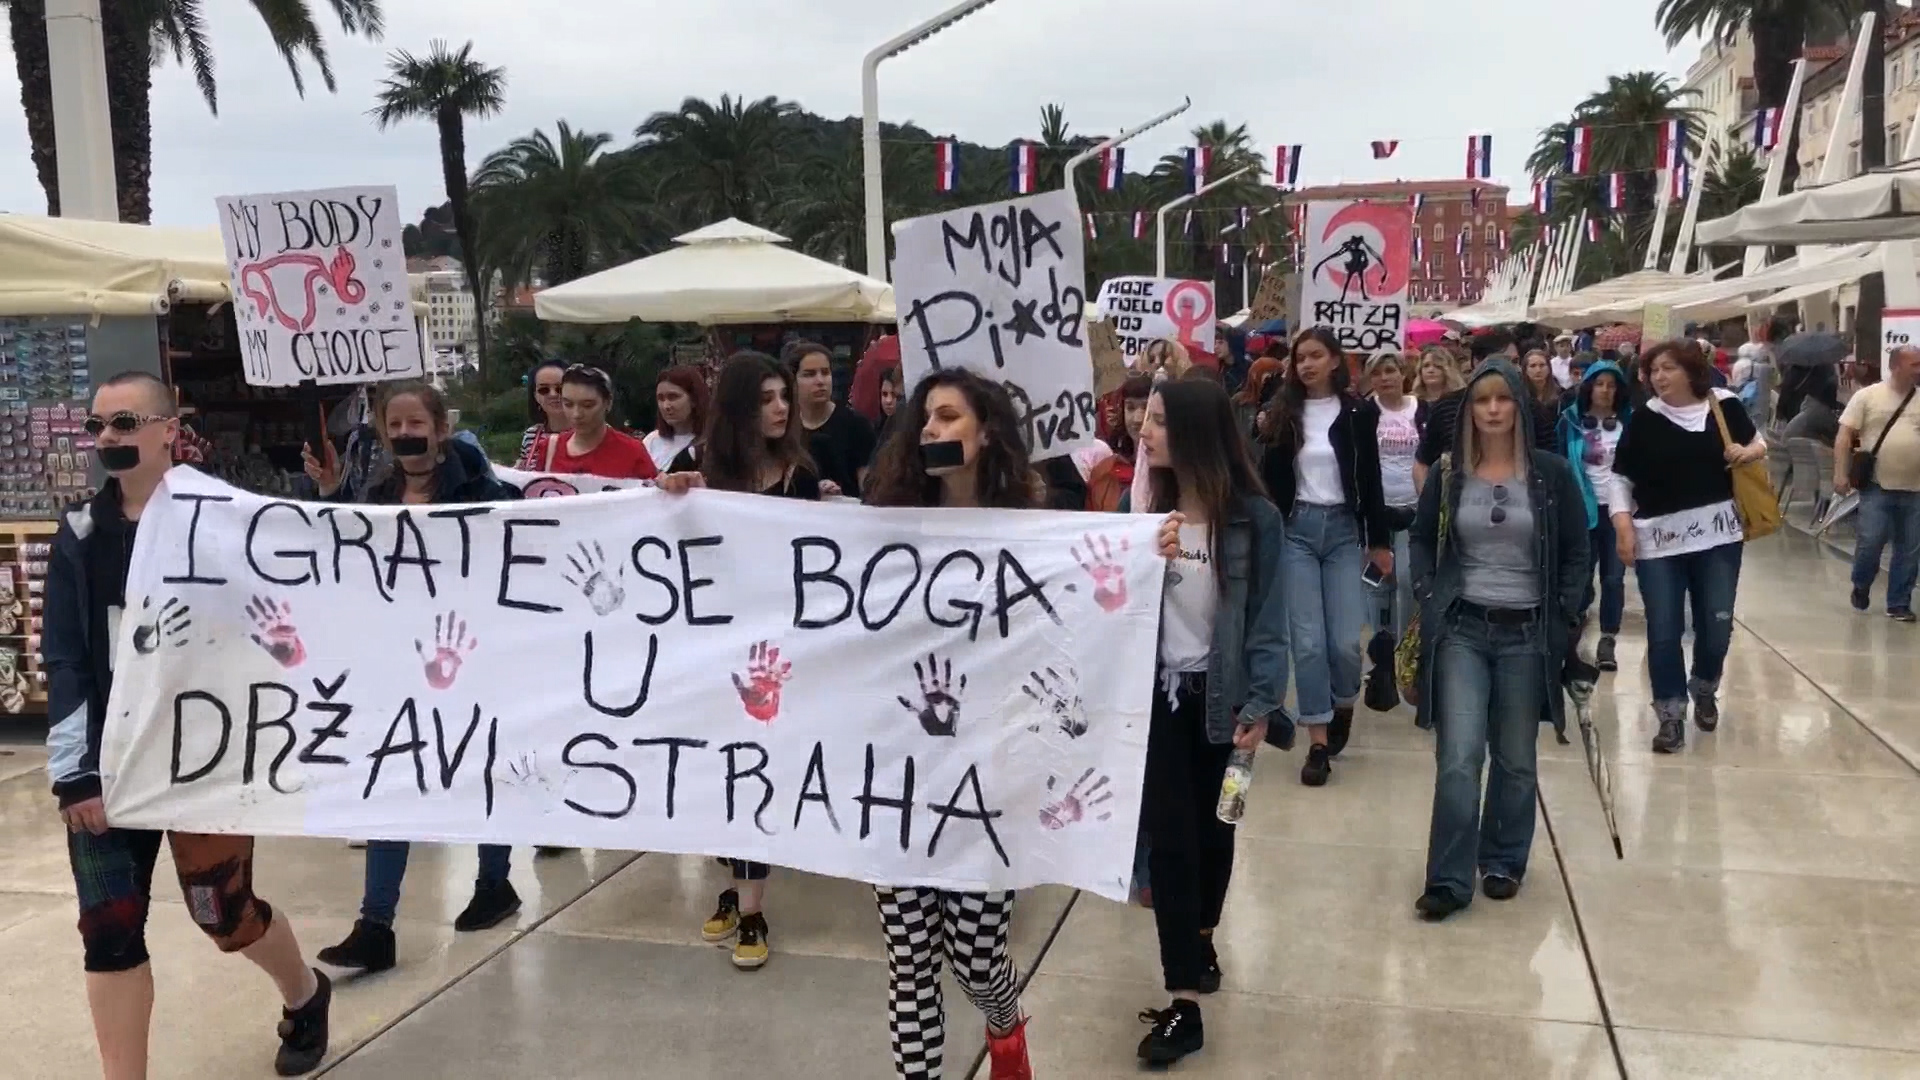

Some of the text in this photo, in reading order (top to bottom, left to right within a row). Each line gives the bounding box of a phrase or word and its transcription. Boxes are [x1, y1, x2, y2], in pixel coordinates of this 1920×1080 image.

[227, 195, 382, 261] MY BODY
[1107, 281, 1154, 296] MOJE
[1107, 297, 1163, 314] TIJELO
[246, 329, 411, 382] MY CHOICE
[1316, 324, 1401, 351] BOR
[631, 535, 733, 625] SE
[791, 536, 1063, 641] BOGA
[584, 630, 658, 717] U
[171, 669, 498, 819] DRŽAVI
[561, 732, 1010, 868] STRAHA
